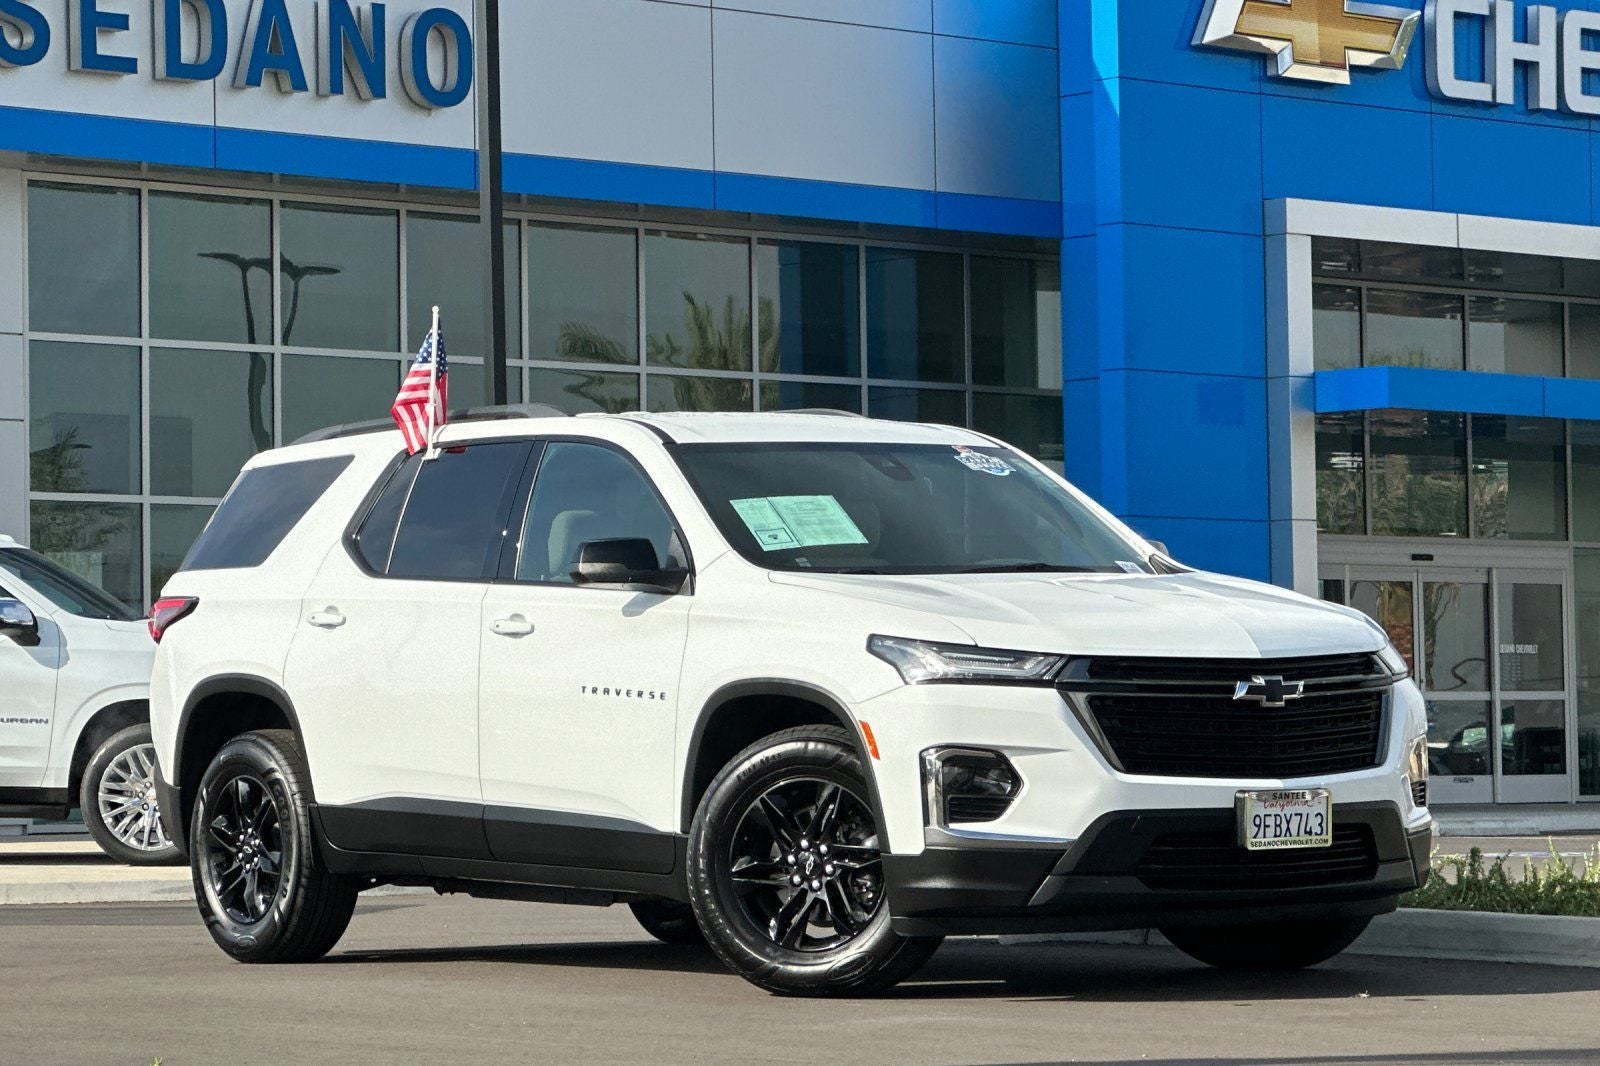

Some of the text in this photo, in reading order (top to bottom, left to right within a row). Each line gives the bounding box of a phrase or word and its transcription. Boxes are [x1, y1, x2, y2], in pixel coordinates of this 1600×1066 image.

[1425, 0, 1600, 115] CHE
[581, 686, 666, 700] TRAVERSE
[1272, 791, 1307, 800] SANTEE
[1252, 812, 1325, 839] 9FBX743
[1250, 838, 1329, 848] SEDANOCHEVROLET.COM
